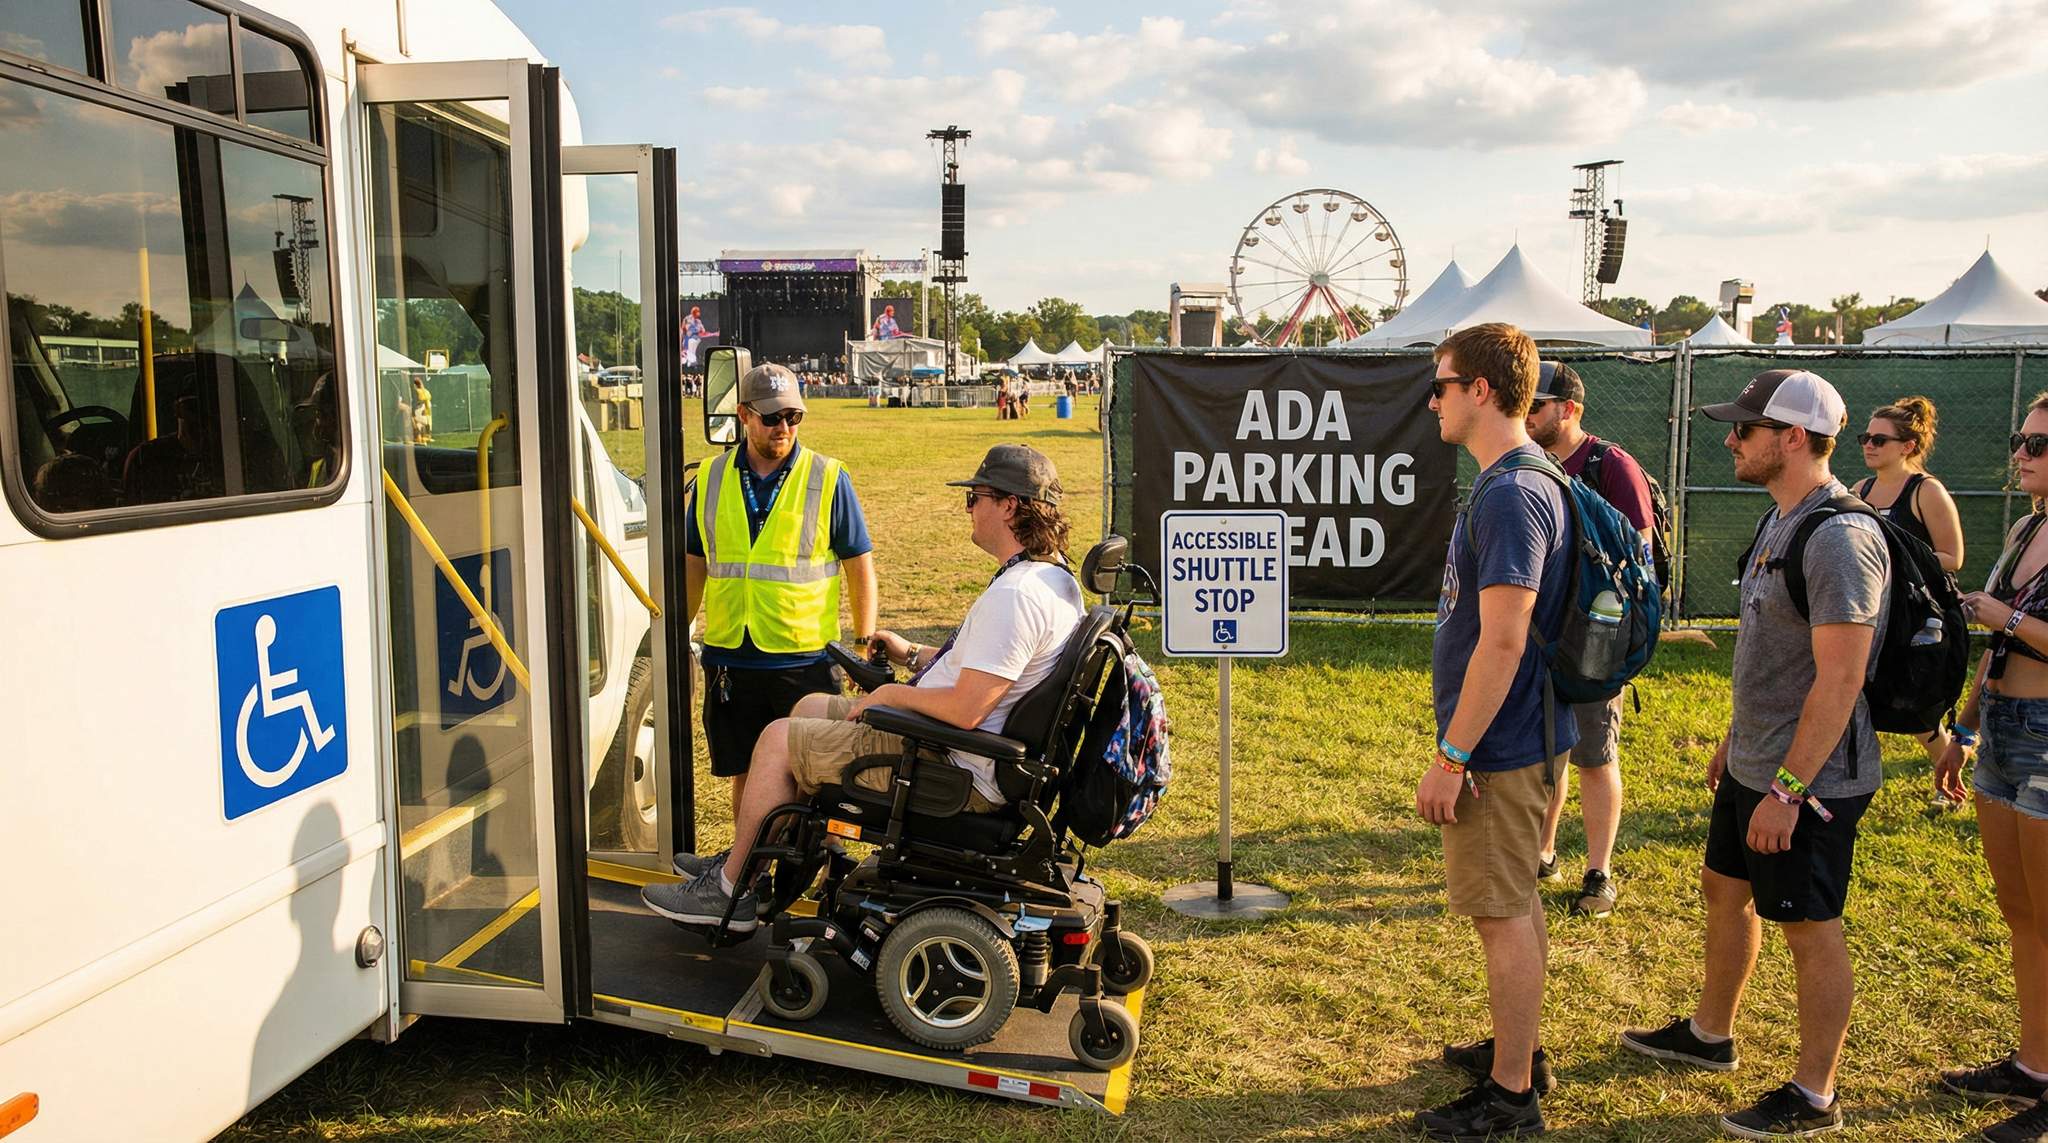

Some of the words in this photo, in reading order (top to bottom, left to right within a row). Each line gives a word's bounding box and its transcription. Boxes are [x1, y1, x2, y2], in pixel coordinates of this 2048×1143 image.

[1235, 390, 1352, 441] ADA
[1173, 451, 1416, 506] PARKING
[1172, 531, 1277, 550] ACCESSIBLE
[1287, 516, 1385, 568] EAD
[1172, 557, 1277, 581] SHUTTLE
[1194, 588, 1255, 613] STOP
